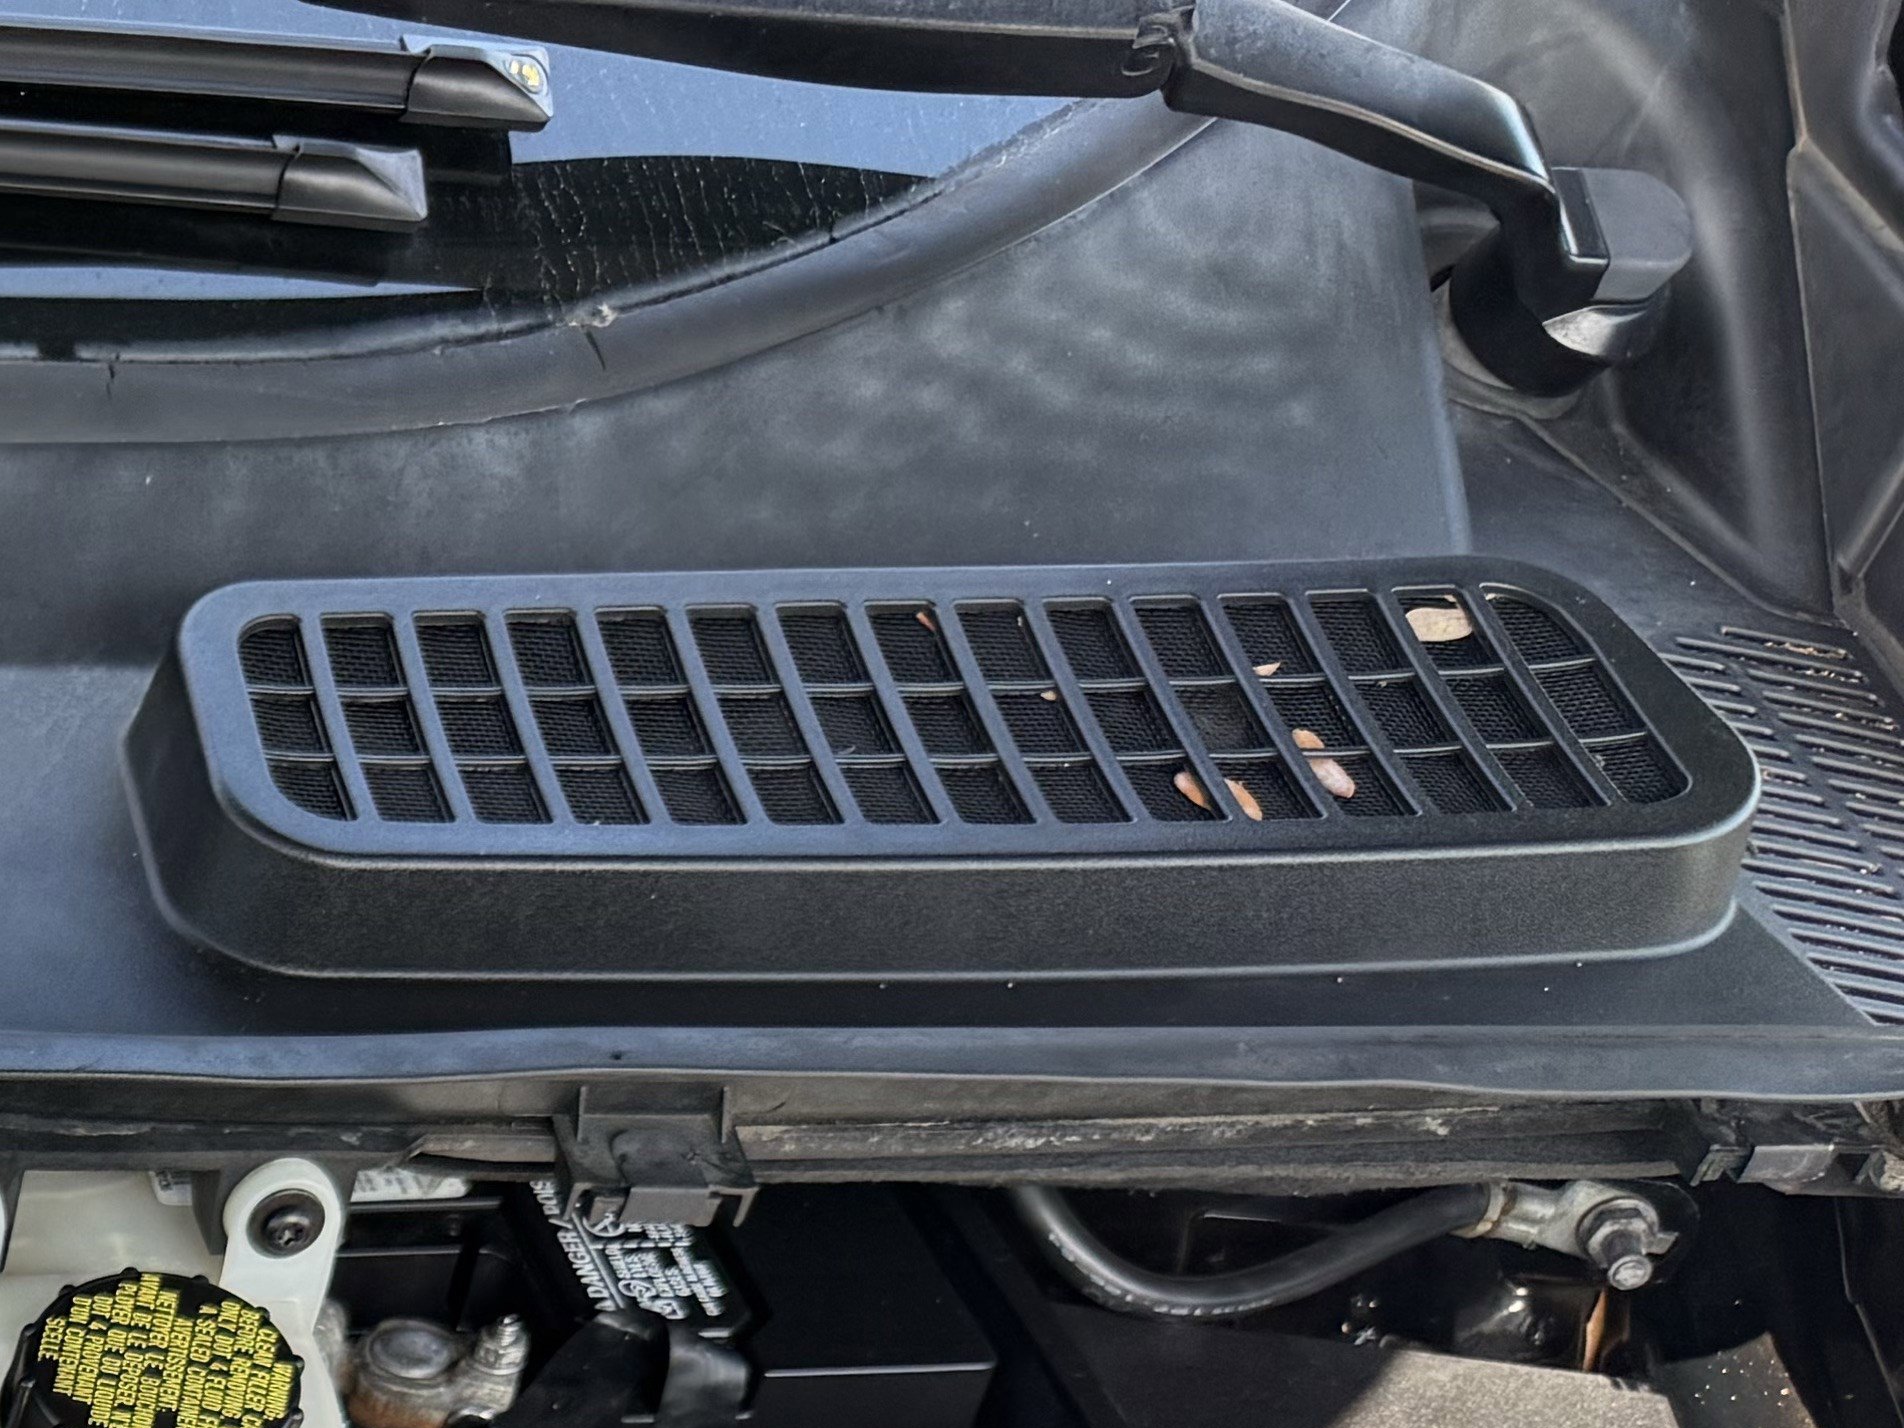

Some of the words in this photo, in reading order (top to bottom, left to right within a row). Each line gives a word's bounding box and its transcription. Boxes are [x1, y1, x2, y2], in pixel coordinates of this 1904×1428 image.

[557, 1229, 610, 1298] DANGER
[69, 1296, 92, 1324] D'UN
[91, 1295, 114, 1319] DOT
[111, 1282, 138, 1326] PLOYER
[136, 1273, 161, 1310] AVANT
[199, 1304, 218, 1315] A
[88, 1320, 108, 1330] 4
[130, 1310, 152, 1329] DE
[149, 1289, 178, 1350] NETTOYER
[217, 1301, 241, 1332] ONLY
[234, 1309, 260, 1355] BEFORE
[104, 1328, 127, 1354] QUE
[126, 1331, 148, 1349] LE
[190, 1318, 217, 1364] SEALED
[213, 1334, 234, 1360] DOT
[253, 1327, 278, 1368] CLEAN
[53, 1327, 87, 1396] CONTENANT
[72, 1332, 104, 1406] PROVENANT
[99, 1356, 122, 1375] DU
[143, 1352, 166, 1370] LE
[209, 1360, 229, 1372] 4
[87, 1378, 117, 1428] LIQUIDE
[201, 1375, 227, 1413] FLUID
[244, 1368, 270, 1412] FILLER
[264, 1362, 293, 1421] WARNING:
